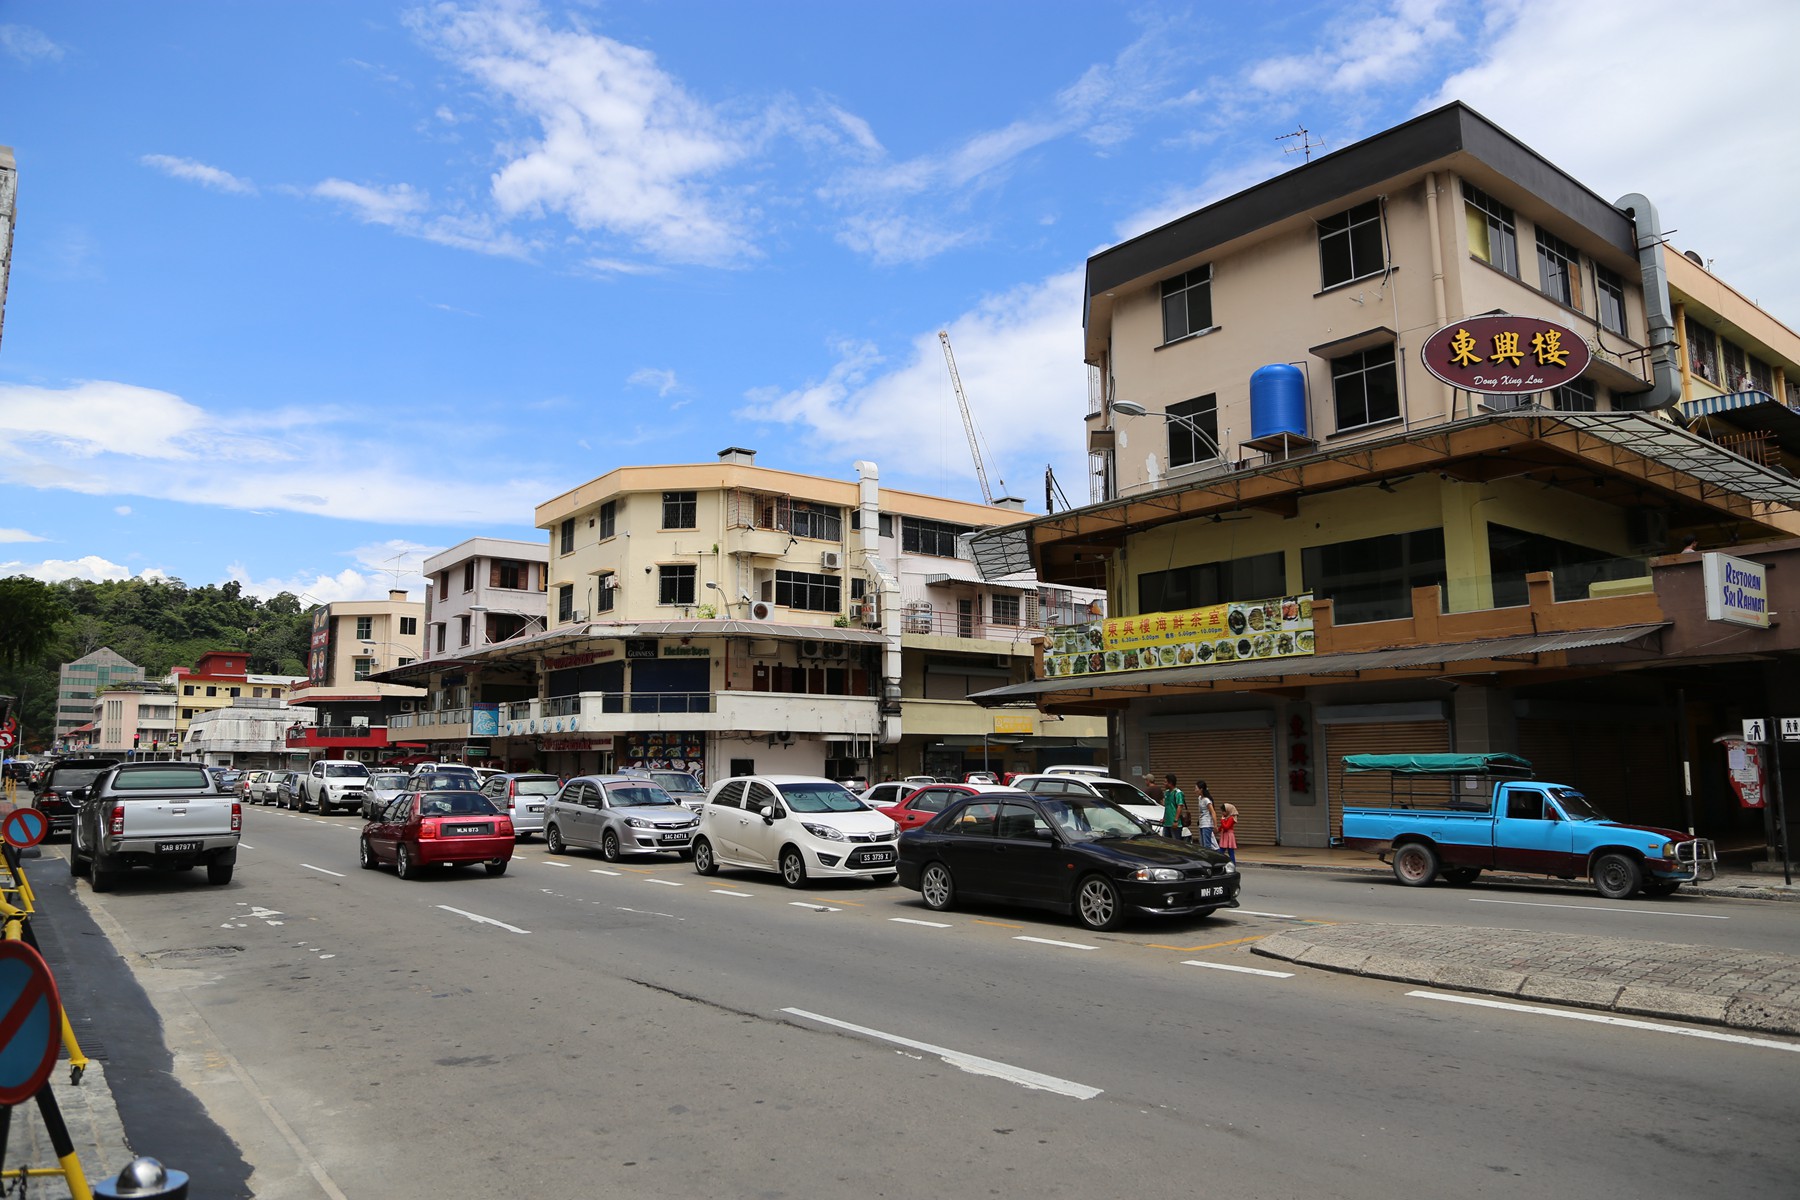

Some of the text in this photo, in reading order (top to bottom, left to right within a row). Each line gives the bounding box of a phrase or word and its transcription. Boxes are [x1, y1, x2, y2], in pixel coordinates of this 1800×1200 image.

[1450, 328, 1570, 367] 東興樓
[1473, 374, 1544, 387] Dong Xing Lou
[1726, 562, 1760, 590] RESTORAN
[1723, 585, 1765, 613] SRI RAHMAT
[1107, 610, 1221, 637] 東興樓海鮮茶室
[664, 646, 710, 656] Heineken
[175, 843, 191, 851] 8797
